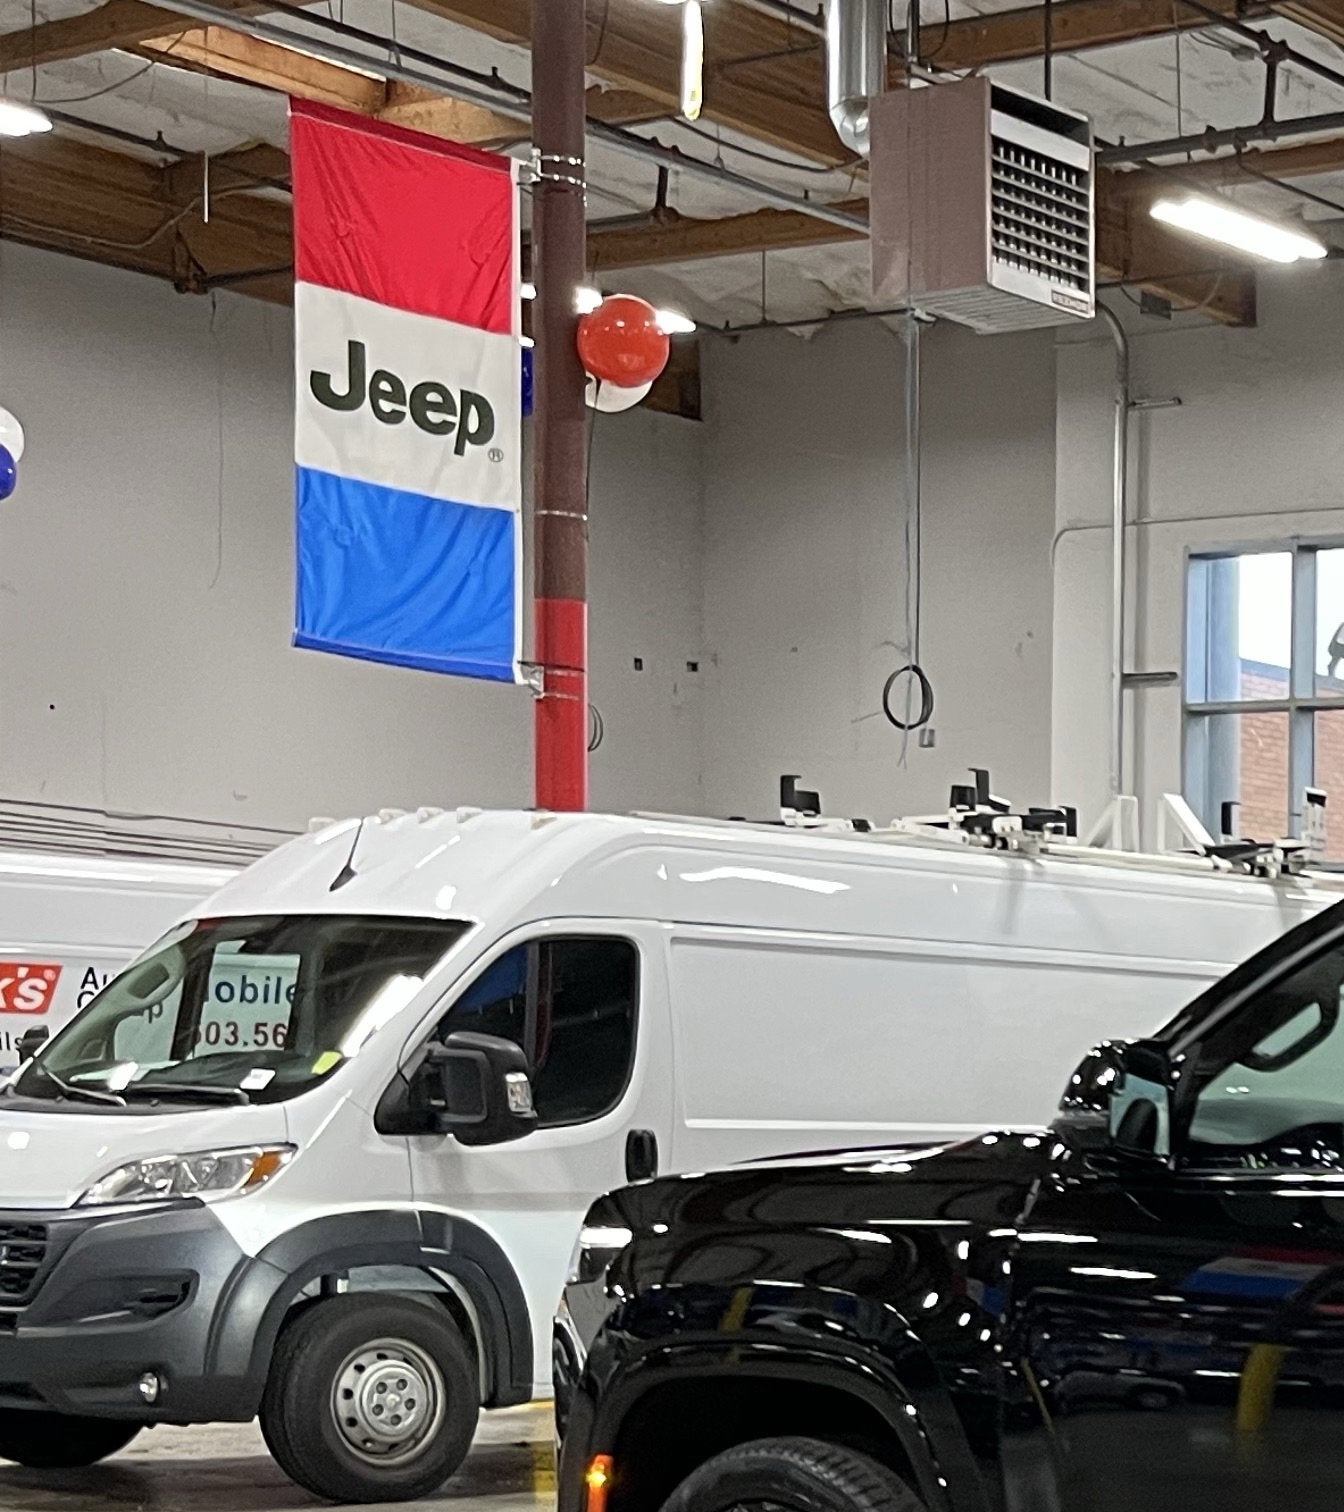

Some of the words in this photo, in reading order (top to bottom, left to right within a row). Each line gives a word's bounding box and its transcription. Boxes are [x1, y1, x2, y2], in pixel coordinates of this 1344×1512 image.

[310, 340, 495, 455] Jeep
[214, 974, 297, 1005] obile
[198, 1020, 288, 1048] 03.56
